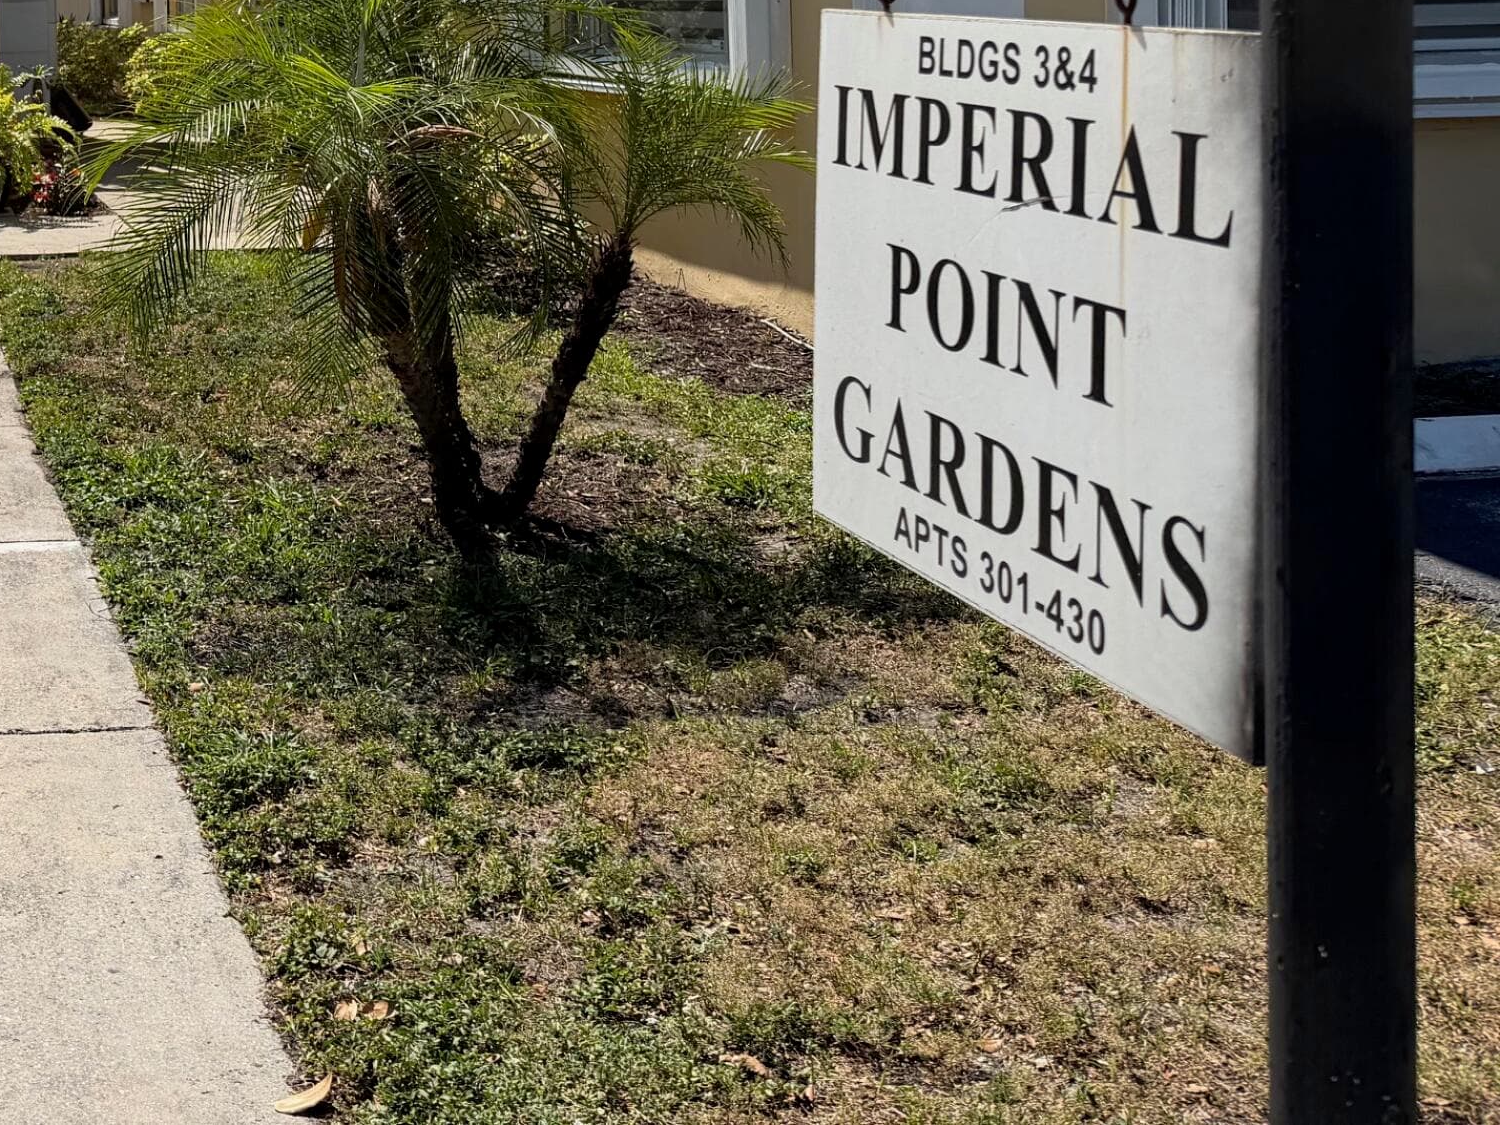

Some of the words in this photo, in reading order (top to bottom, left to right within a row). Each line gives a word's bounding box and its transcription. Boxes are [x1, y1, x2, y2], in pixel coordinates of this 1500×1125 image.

[918, 35, 1021, 85] BLDGS
[1033, 45, 1098, 94] 3&4
[832, 85, 1234, 249] IMPERIAL
[885, 242, 1128, 409] POINT
[833, 375, 1209, 632] GARDENS
[894, 506, 968, 579] APTS
[979, 551, 1106, 656] 301-430
